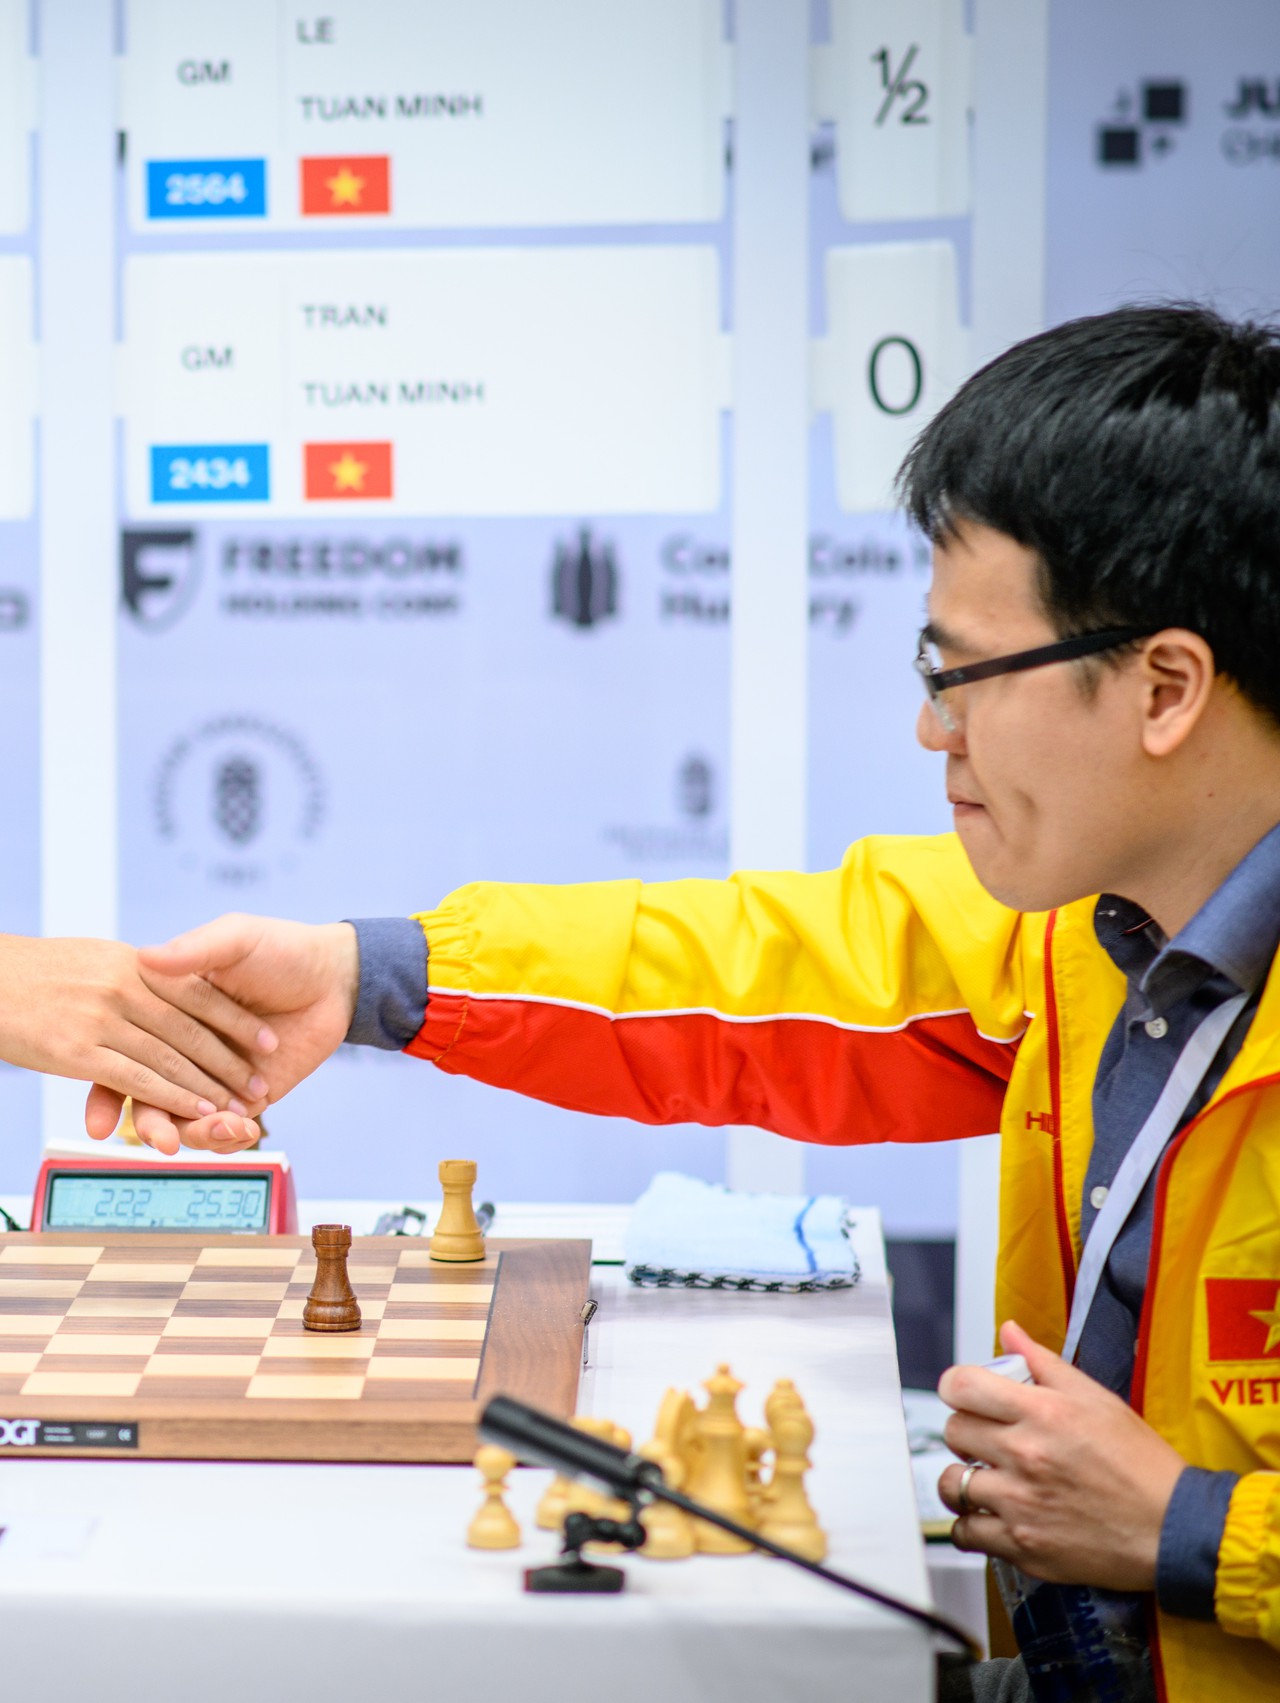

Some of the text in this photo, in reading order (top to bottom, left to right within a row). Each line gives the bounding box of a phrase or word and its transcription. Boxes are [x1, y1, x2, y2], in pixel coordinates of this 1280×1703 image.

[296, 18, 335, 44] LE
[178, 60, 231, 86] GM
[300, 94, 484, 121] TUAN MINH
[165, 174, 246, 205] 2564
[302, 304, 388, 329] TRAN
[180, 344, 234, 370] GM
[303, 380, 486, 406] TUAN MINH
[168, 458, 250, 490] 2434
[222, 542, 462, 577] FREEDOM
[186, 1189, 262, 1219] 25.30
[1210, 1378, 1280, 1406] VIET
